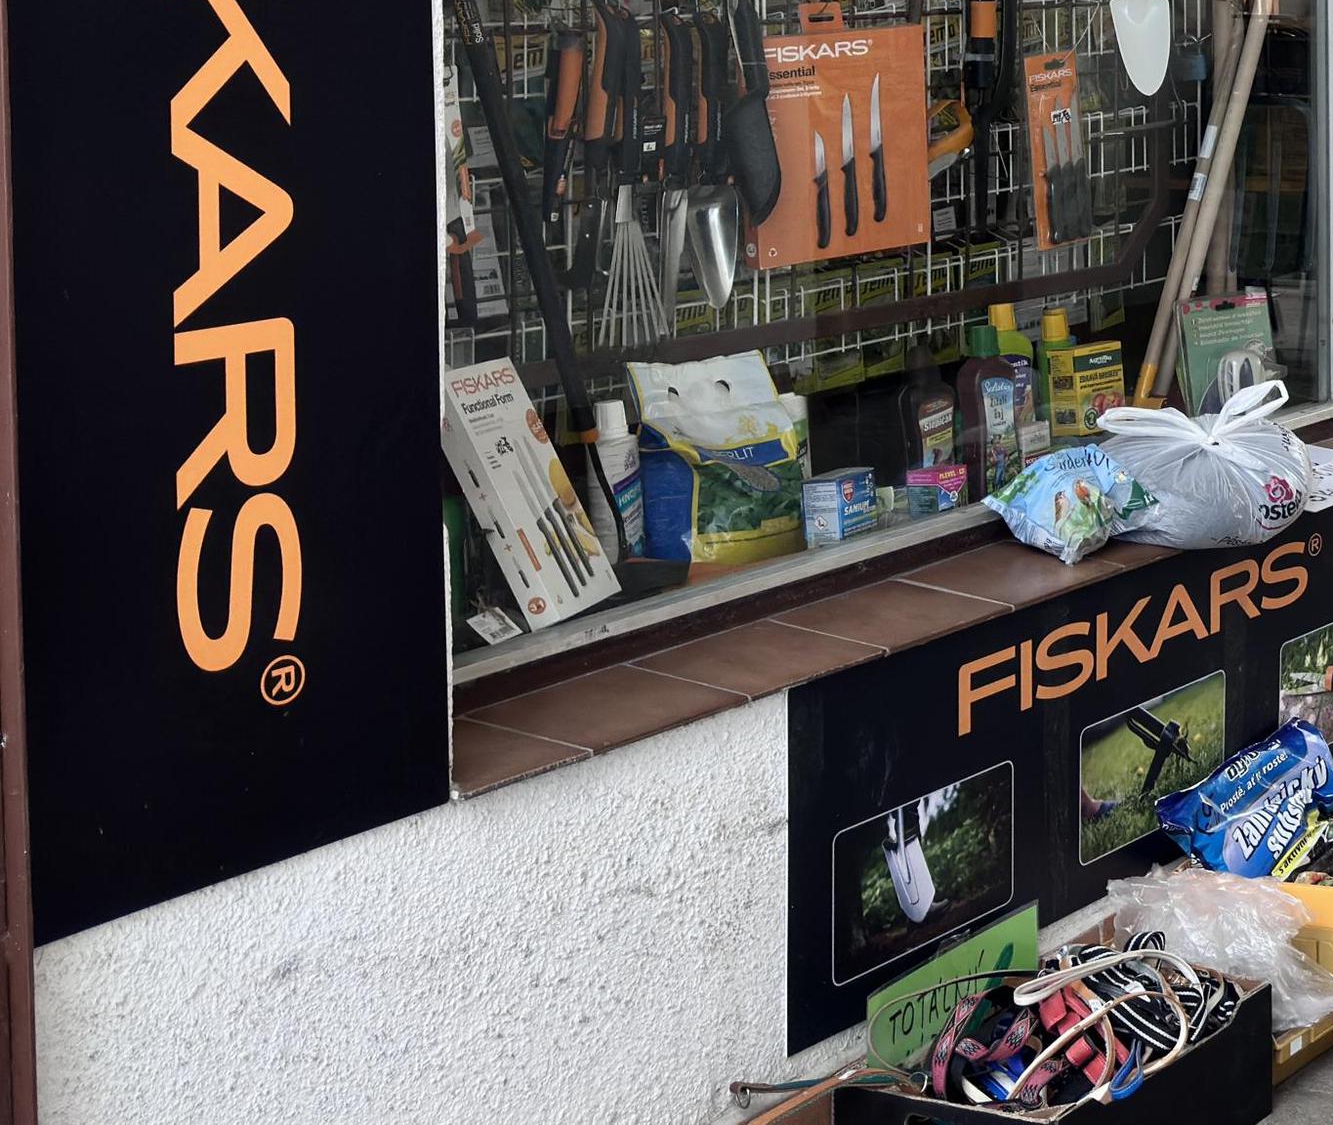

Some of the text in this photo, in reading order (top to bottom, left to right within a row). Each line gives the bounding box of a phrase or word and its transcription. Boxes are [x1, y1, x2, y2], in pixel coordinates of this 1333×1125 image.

[472, 23, 486, 44] Solid
[769, 65, 815, 80] ssential
[452, 367, 516, 397] FISKARS
[461, 392, 514, 415] Functional Form
[844, 501, 871, 516] SANIUM
